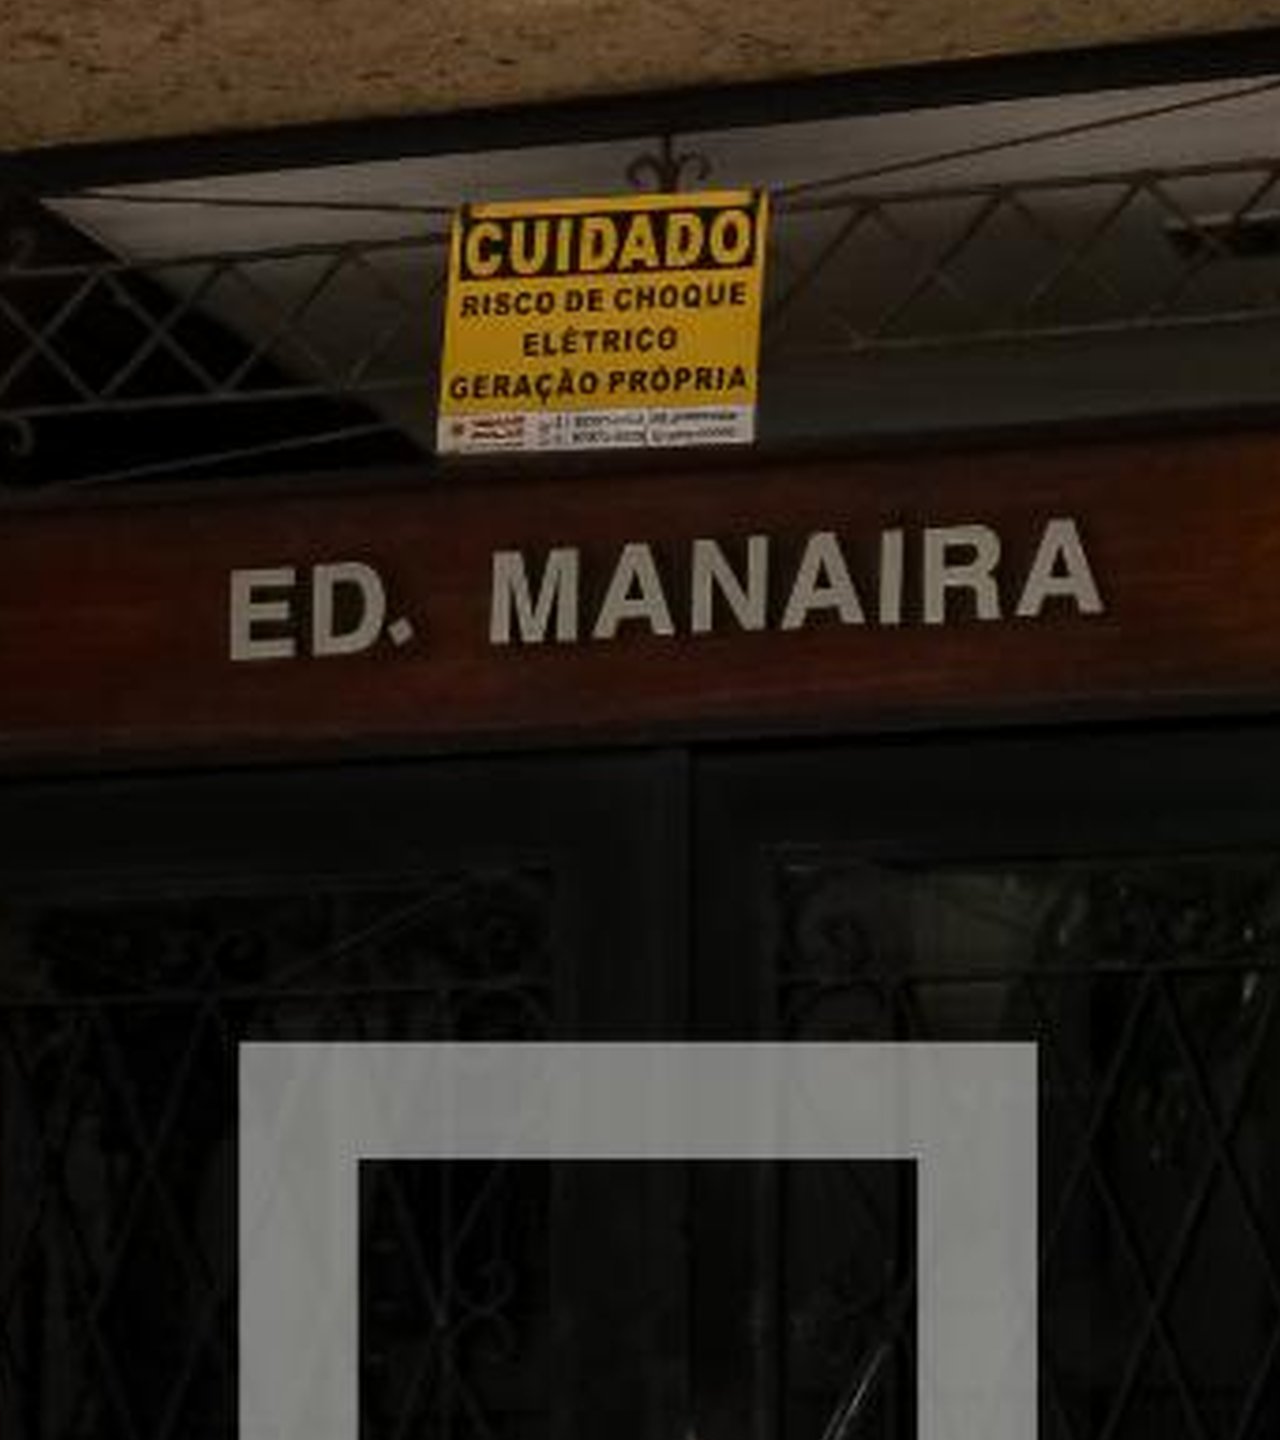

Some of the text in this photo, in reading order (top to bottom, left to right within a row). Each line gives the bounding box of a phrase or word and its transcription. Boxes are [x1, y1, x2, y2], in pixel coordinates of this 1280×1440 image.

[466, 208, 751, 277] CUIDADO
[461, 281, 747, 317] RISCO DE CHOQUE
[523, 326, 678, 358] ELÉTRICO
[450, 365, 747, 405] GERAÇÃO PRÓPRIA
[229, 517, 1104, 661] ED. MANAIRA
